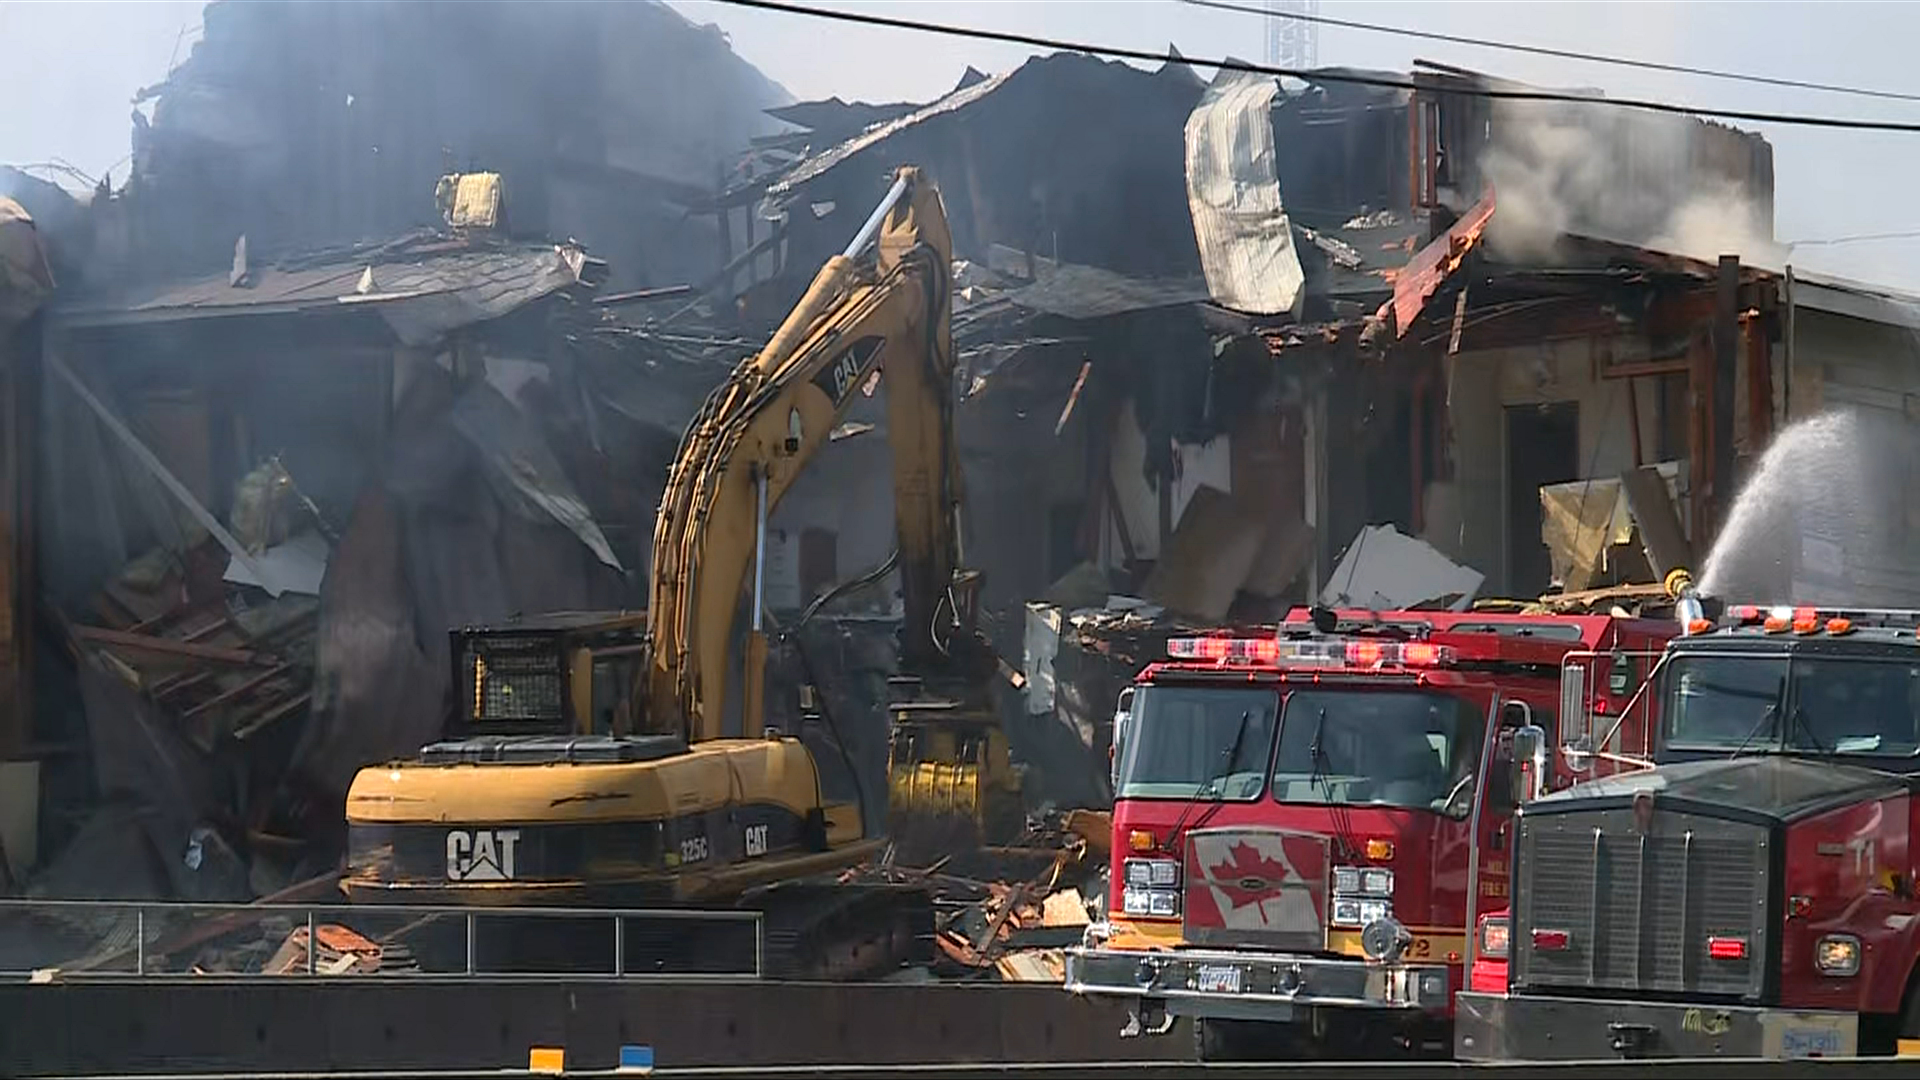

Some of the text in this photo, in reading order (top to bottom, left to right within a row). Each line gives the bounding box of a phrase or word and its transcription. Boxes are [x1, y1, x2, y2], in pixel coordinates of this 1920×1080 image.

[834, 348, 859, 397] CAT
[447, 830, 520, 880] CAT
[681, 837, 708, 862] 325C
[746, 824, 768, 857] CAT
